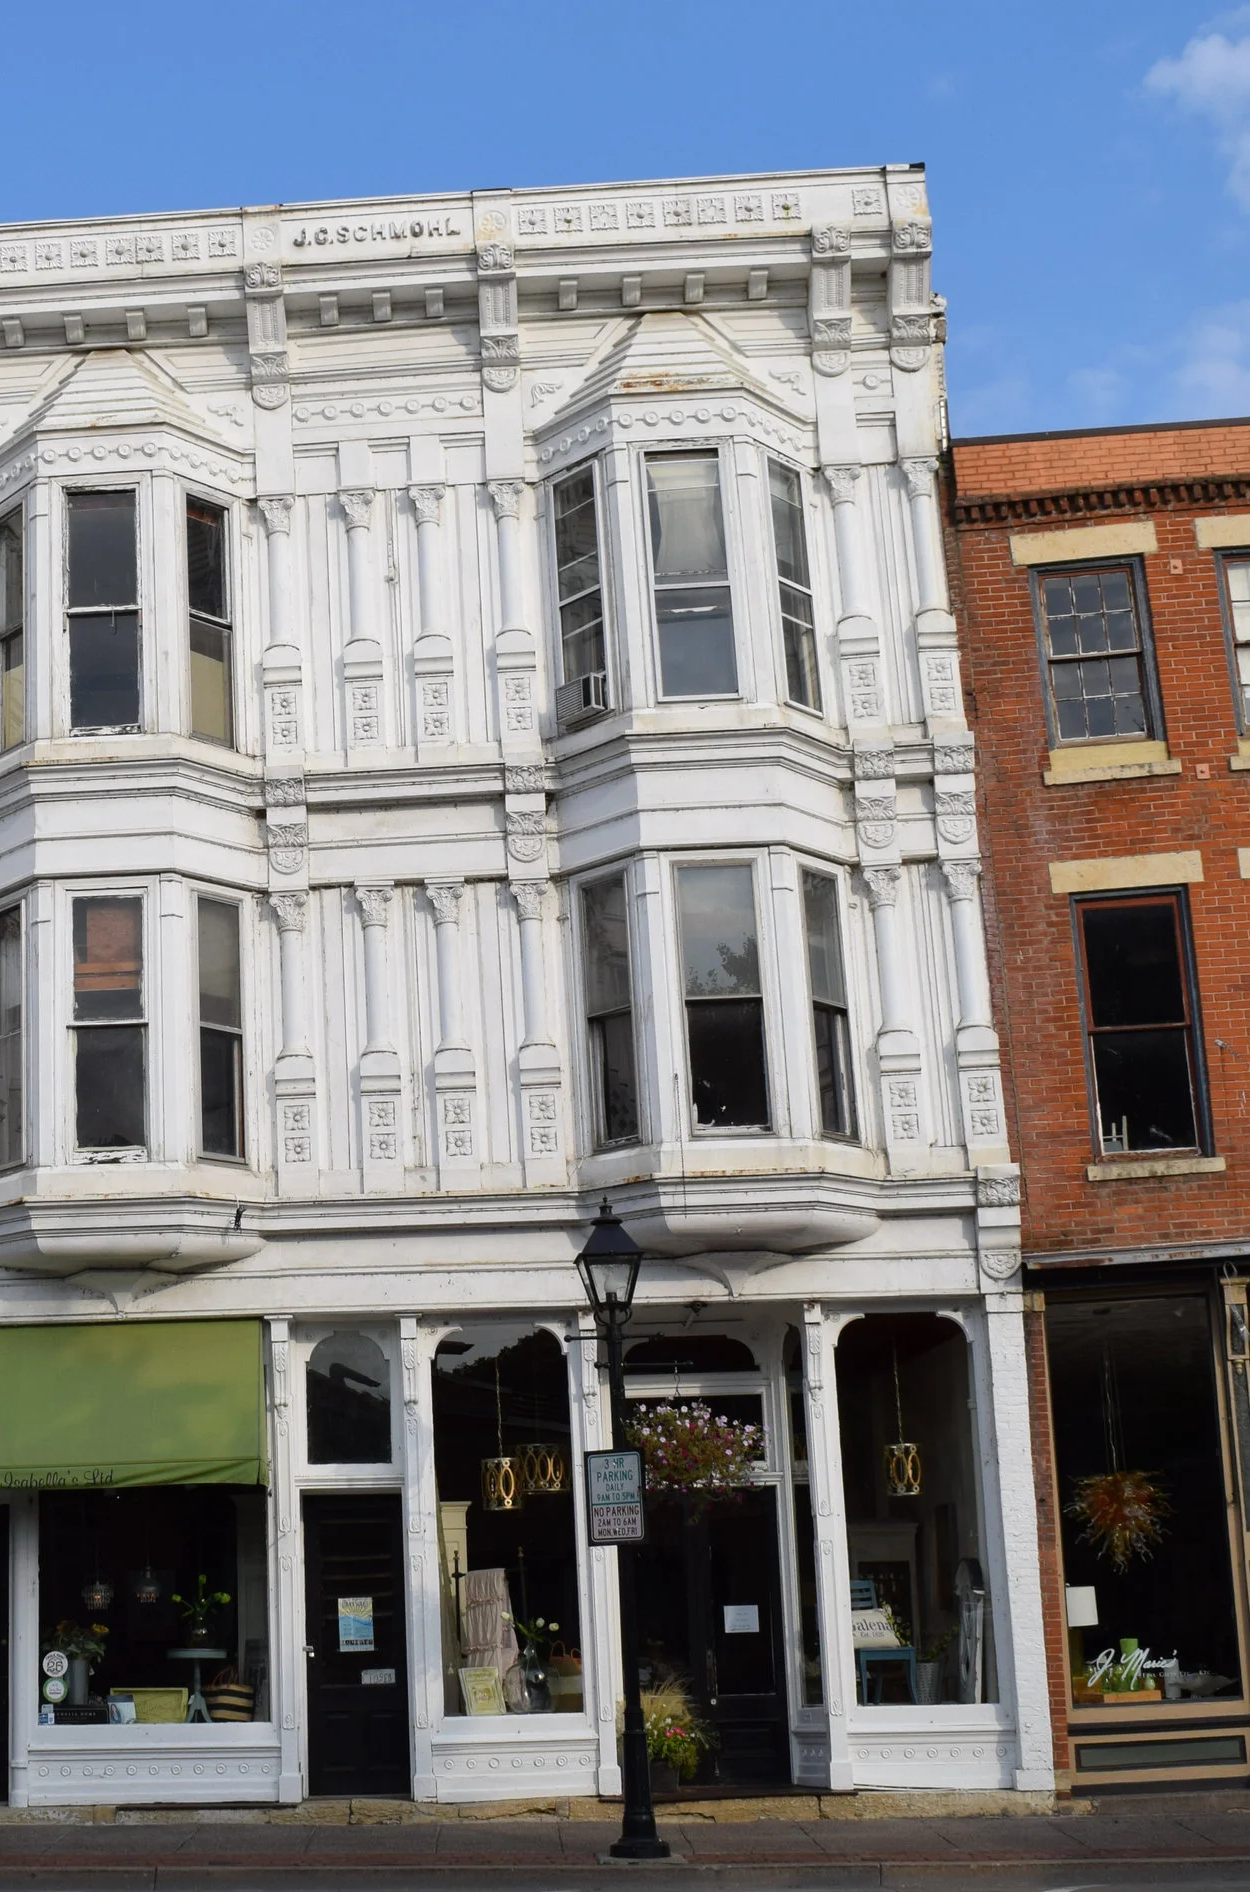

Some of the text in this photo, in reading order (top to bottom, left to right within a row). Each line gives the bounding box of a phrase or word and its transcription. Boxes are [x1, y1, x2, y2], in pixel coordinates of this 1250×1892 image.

[604, 1457, 625, 1469] 3 HR
[597, 1469, 633, 1482] PARKING
[606, 1482, 625, 1492] DAILY
[597, 1491, 635, 1502] 9AM TO 5PM
[594, 1505, 639, 1517] NO PARKING
[598, 1516, 637, 1528] 2AM TO 6AM
